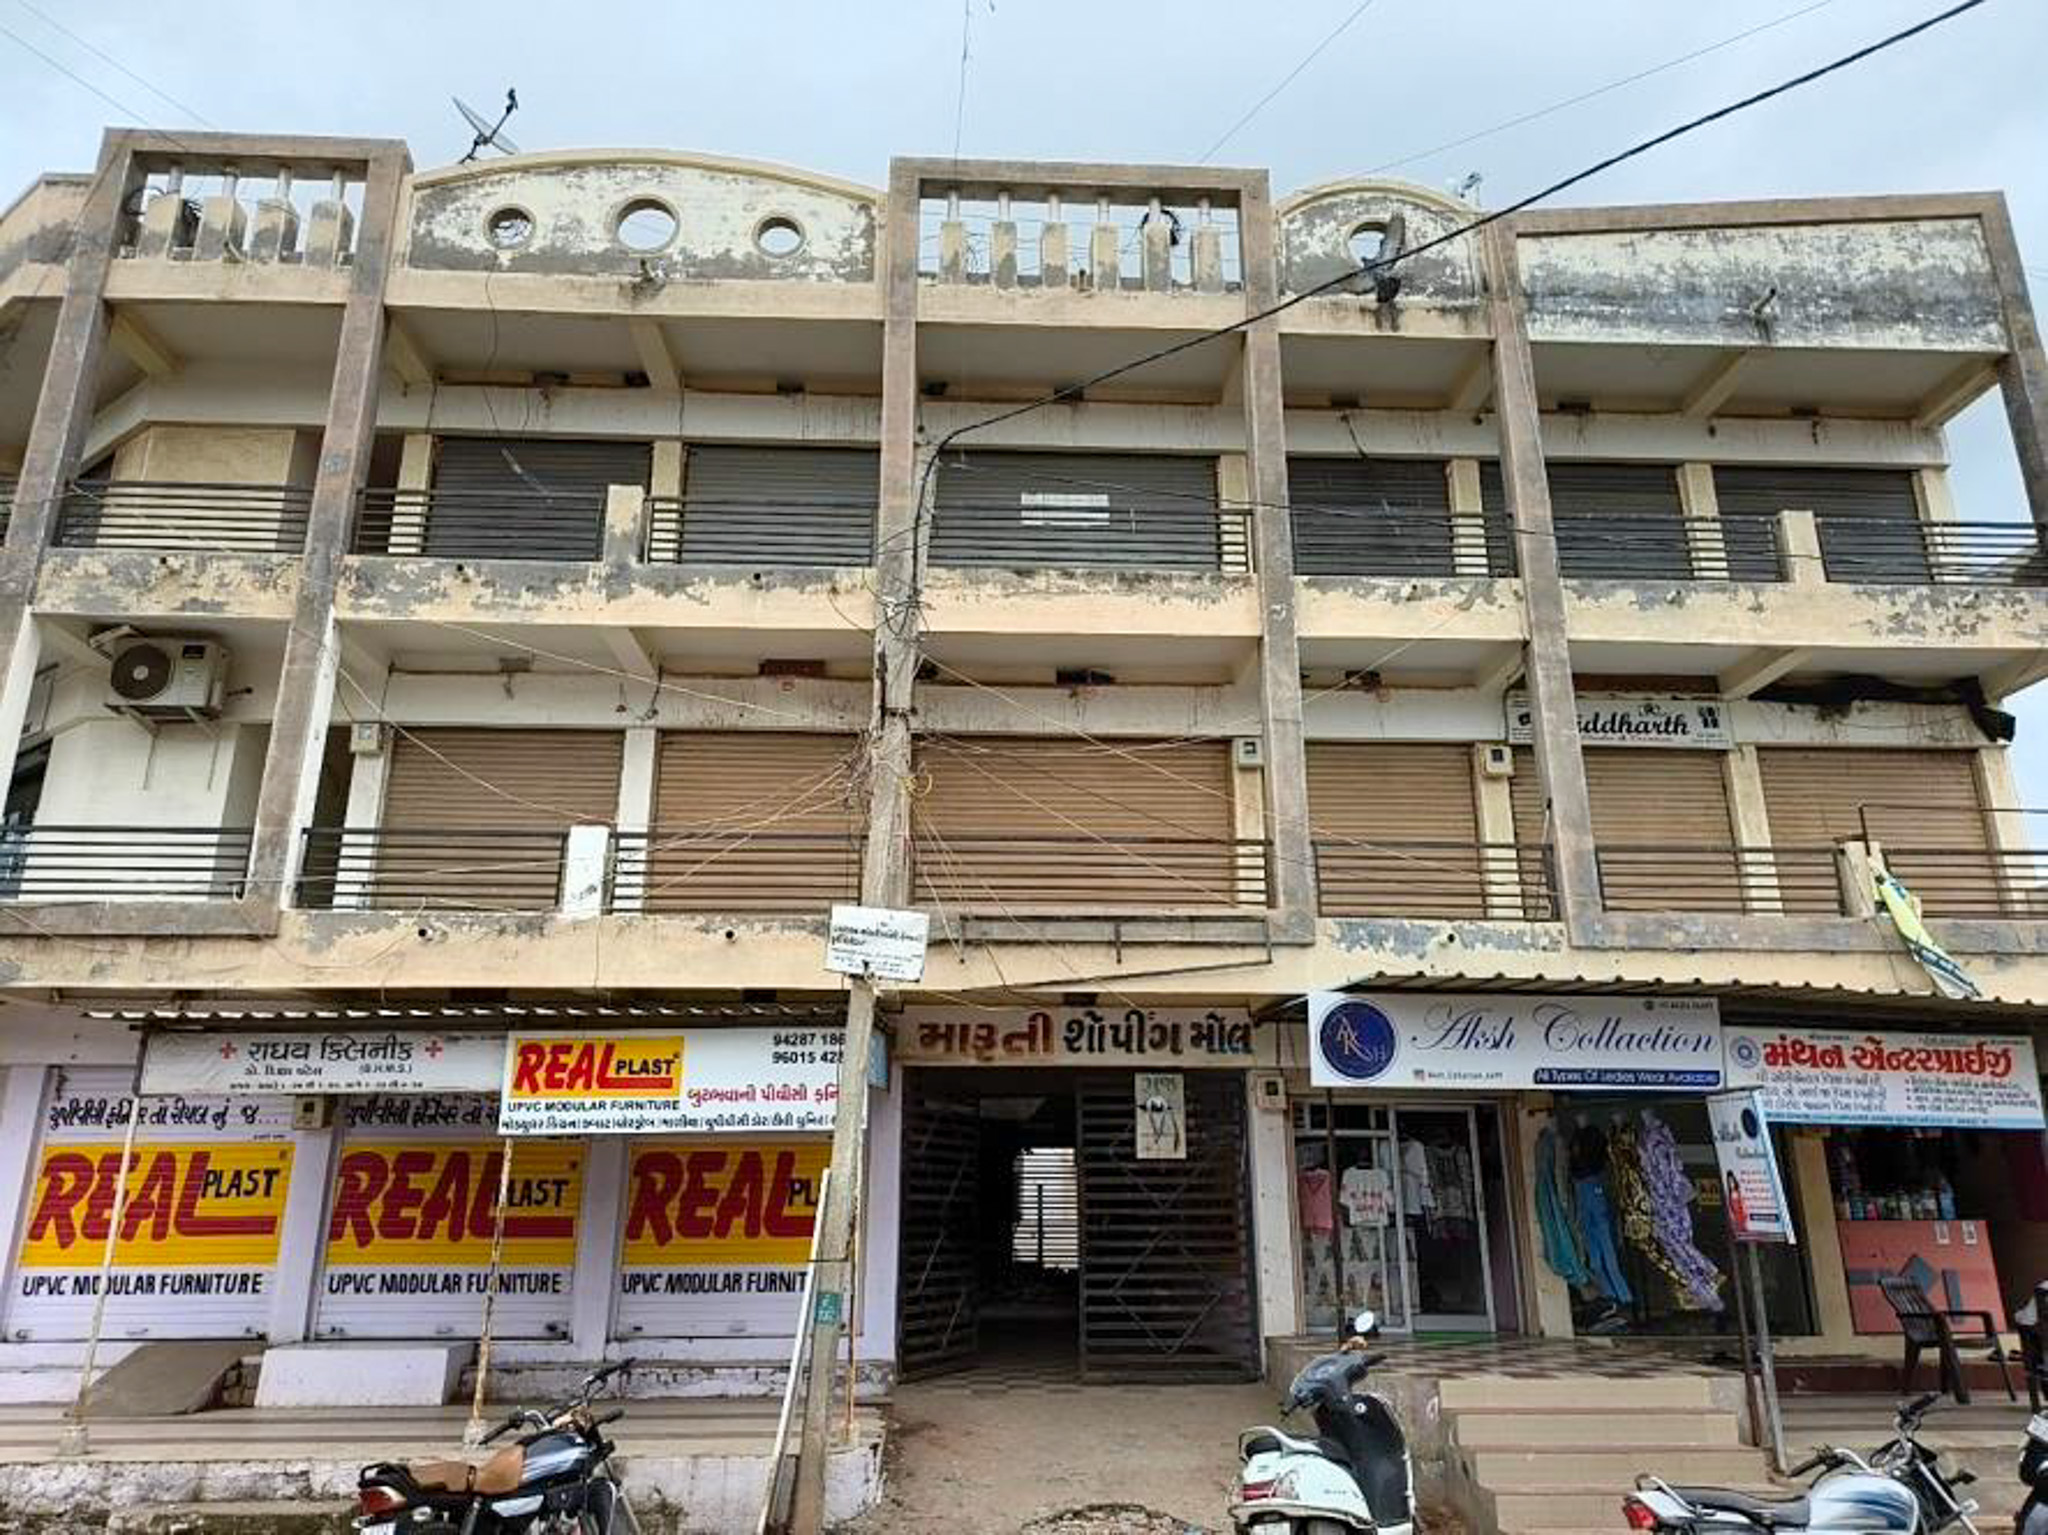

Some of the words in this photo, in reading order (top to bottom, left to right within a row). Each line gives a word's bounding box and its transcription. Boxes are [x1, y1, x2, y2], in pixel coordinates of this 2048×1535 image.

[1576, 711, 1691, 736] iddharth
[774, 1032, 816, 1046] 94287
[1411, 1002, 1516, 1050] Aksh
[1533, 1003, 1716, 1053] Collaction
[248, 1040, 311, 1061] રાઘવ
[772, 1051, 816, 1064] 96015
[1763, 1033, 1847, 1069] મંથન
[513, 1042, 673, 1094] REAL
[615, 1058, 676, 1075] PLAST
[508, 1100, 542, 1112] UPVC
[545, 1100, 607, 1112] MODULAR
[610, 1099, 680, 1111] FURNITURE
[28, 1151, 277, 1249] REAL
[201, 1169, 280, 1198] PLAST
[328, 1151, 573, 1249] REAL
[626, 1151, 814, 1247] REAL
[788, 1178, 817, 1206] PL
[22, 1276, 68, 1296] UPVC
[160, 1273, 263, 1294] FURNITURE
[328, 1273, 376, 1294] UPVC
[379, 1273, 462, 1294] MODULAR
[466, 1272, 562, 1293] FUNITURE
[622, 1273, 663, 1294] UPVC
[664, 1273, 743, 1294] MODULAR
[747, 1272, 807, 1293] FURNIT
